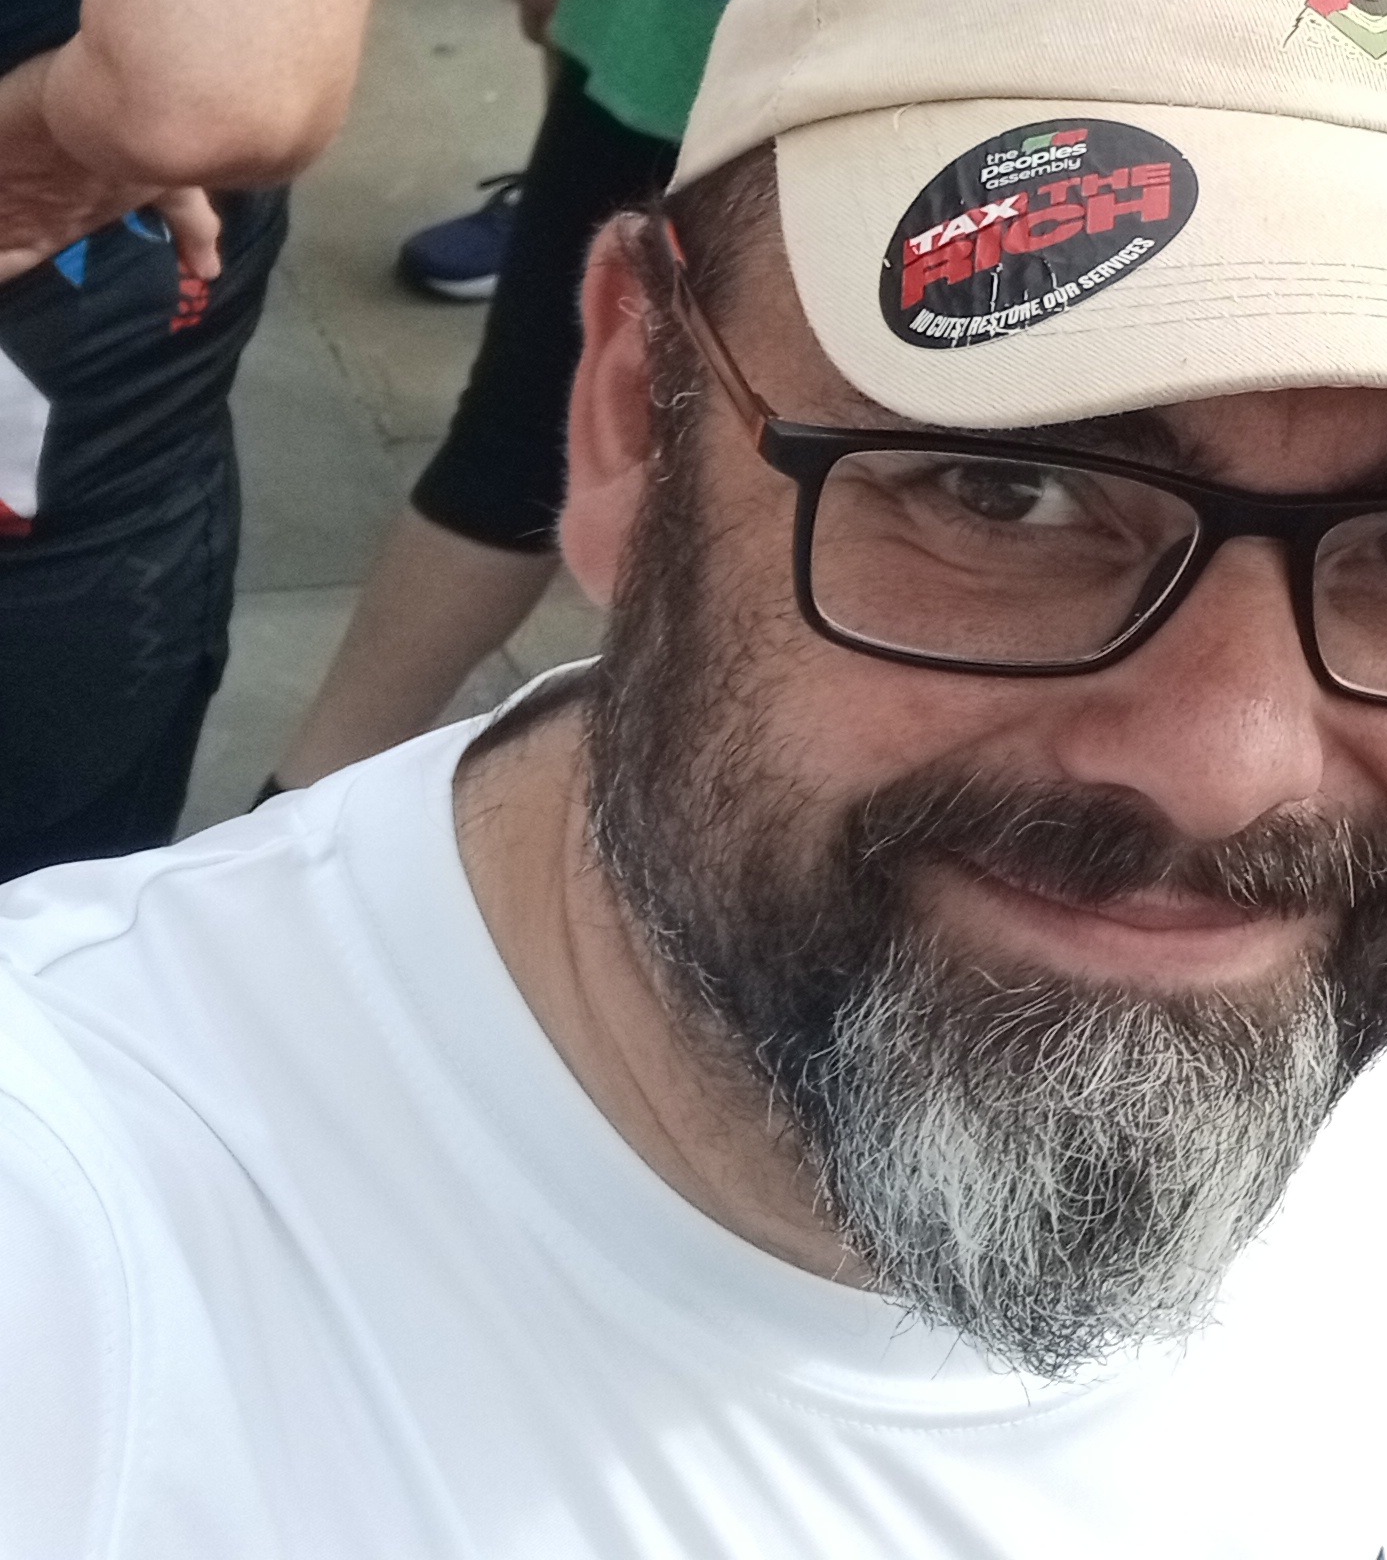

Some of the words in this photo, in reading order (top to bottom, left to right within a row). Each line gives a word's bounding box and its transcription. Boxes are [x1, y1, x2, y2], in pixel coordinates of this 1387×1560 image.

[980, 142, 1088, 184] peoples
[985, 149, 1019, 166] the
[985, 157, 1082, 191] assembly
[909, 194, 1020, 256] TAX
[1038, 162, 1172, 205] THE
[900, 186, 1172, 311] RICH
[1042, 283, 1082, 311] OUR
[1078, 236, 1157, 291] SERVICES
